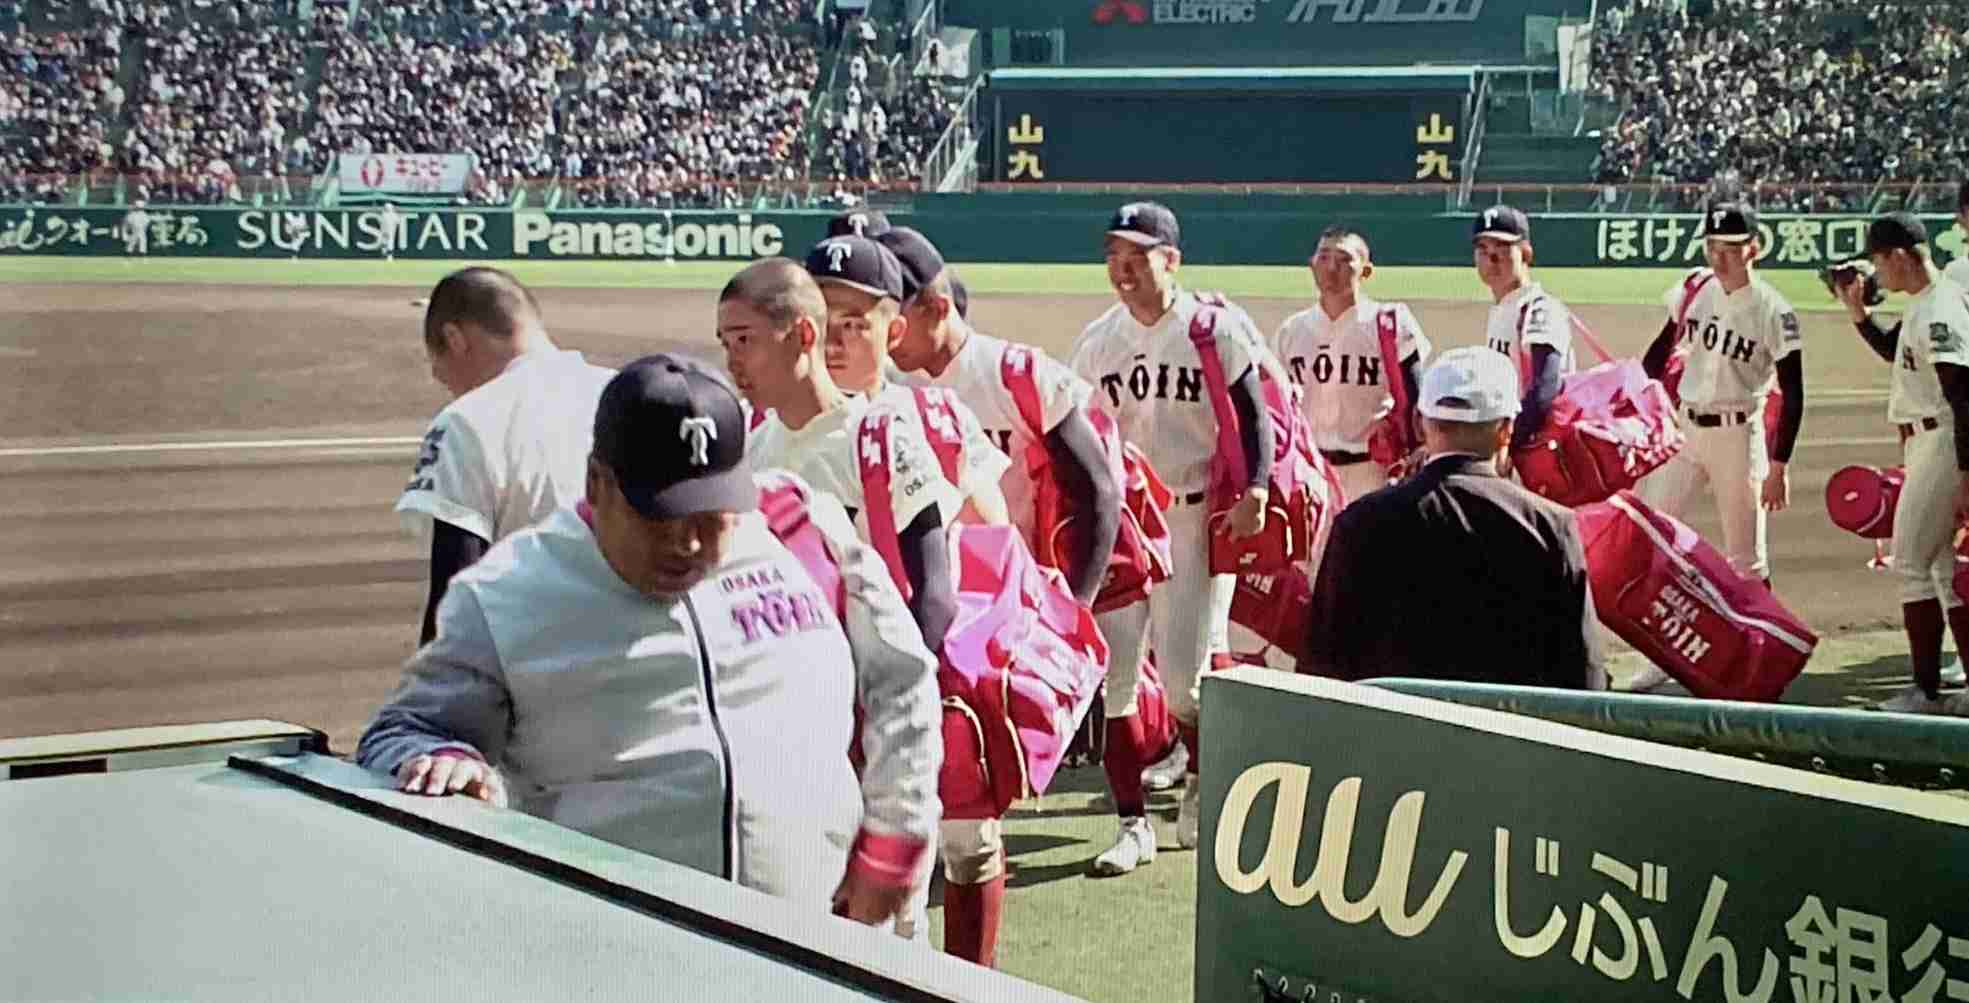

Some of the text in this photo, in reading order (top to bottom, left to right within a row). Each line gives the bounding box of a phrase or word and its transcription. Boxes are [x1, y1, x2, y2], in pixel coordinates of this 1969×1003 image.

[1008, 115, 1044, 179] 山九
[1417, 115, 1453, 180] 山九
[45, 213, 208, 248] クオー薬局
[237, 211, 488, 250] SUNSTAR
[513, 212, 784, 256] Panasonic
[826, 242, 851, 272] T
[679, 416, 718, 466] T
[1214, 761, 1468, 937] au
